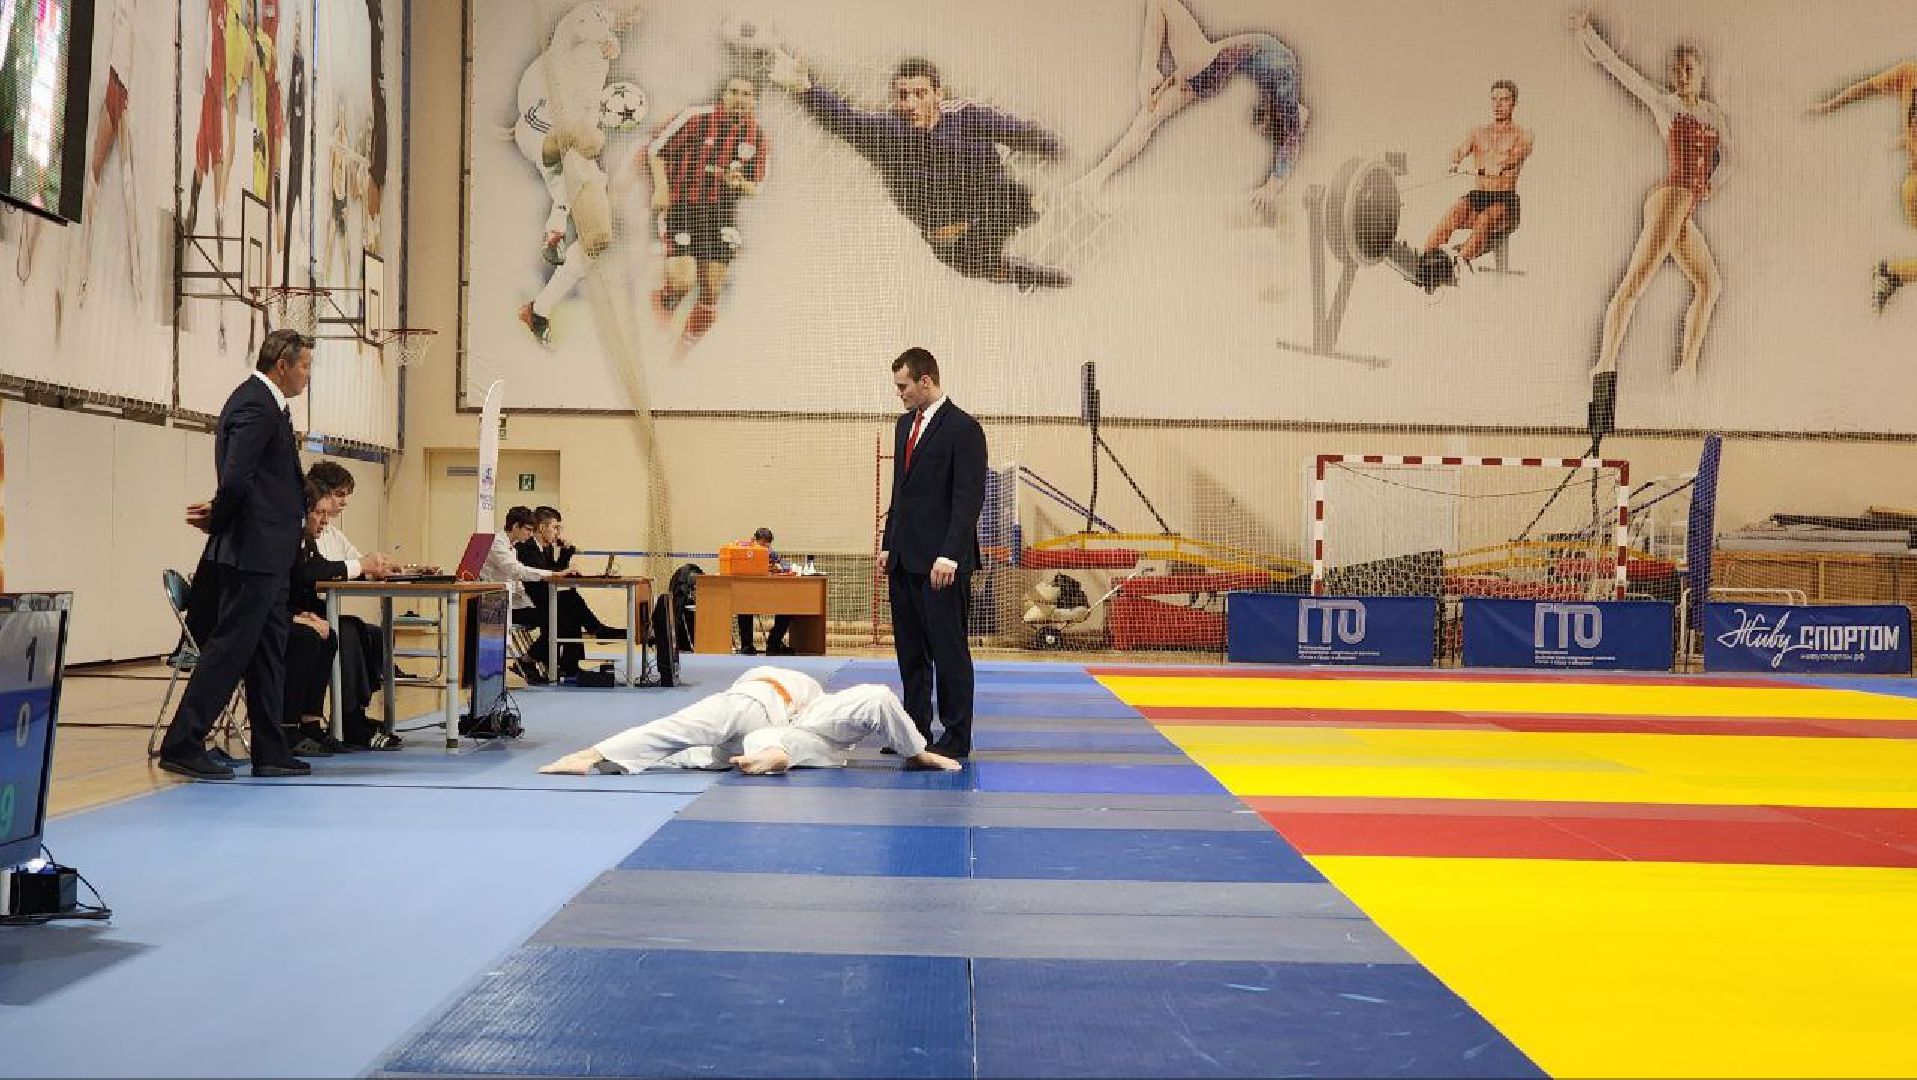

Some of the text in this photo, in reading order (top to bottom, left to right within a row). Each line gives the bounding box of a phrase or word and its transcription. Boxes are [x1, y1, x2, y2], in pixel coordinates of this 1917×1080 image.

[1298, 598, 1366, 645] ГТО
[1535, 603, 1602, 649] ГТО
[1716, 608, 1900, 669] Живу СПОРТОМ
[26, 636, 37, 683] 1
[16, 703, 30, 748] 0
